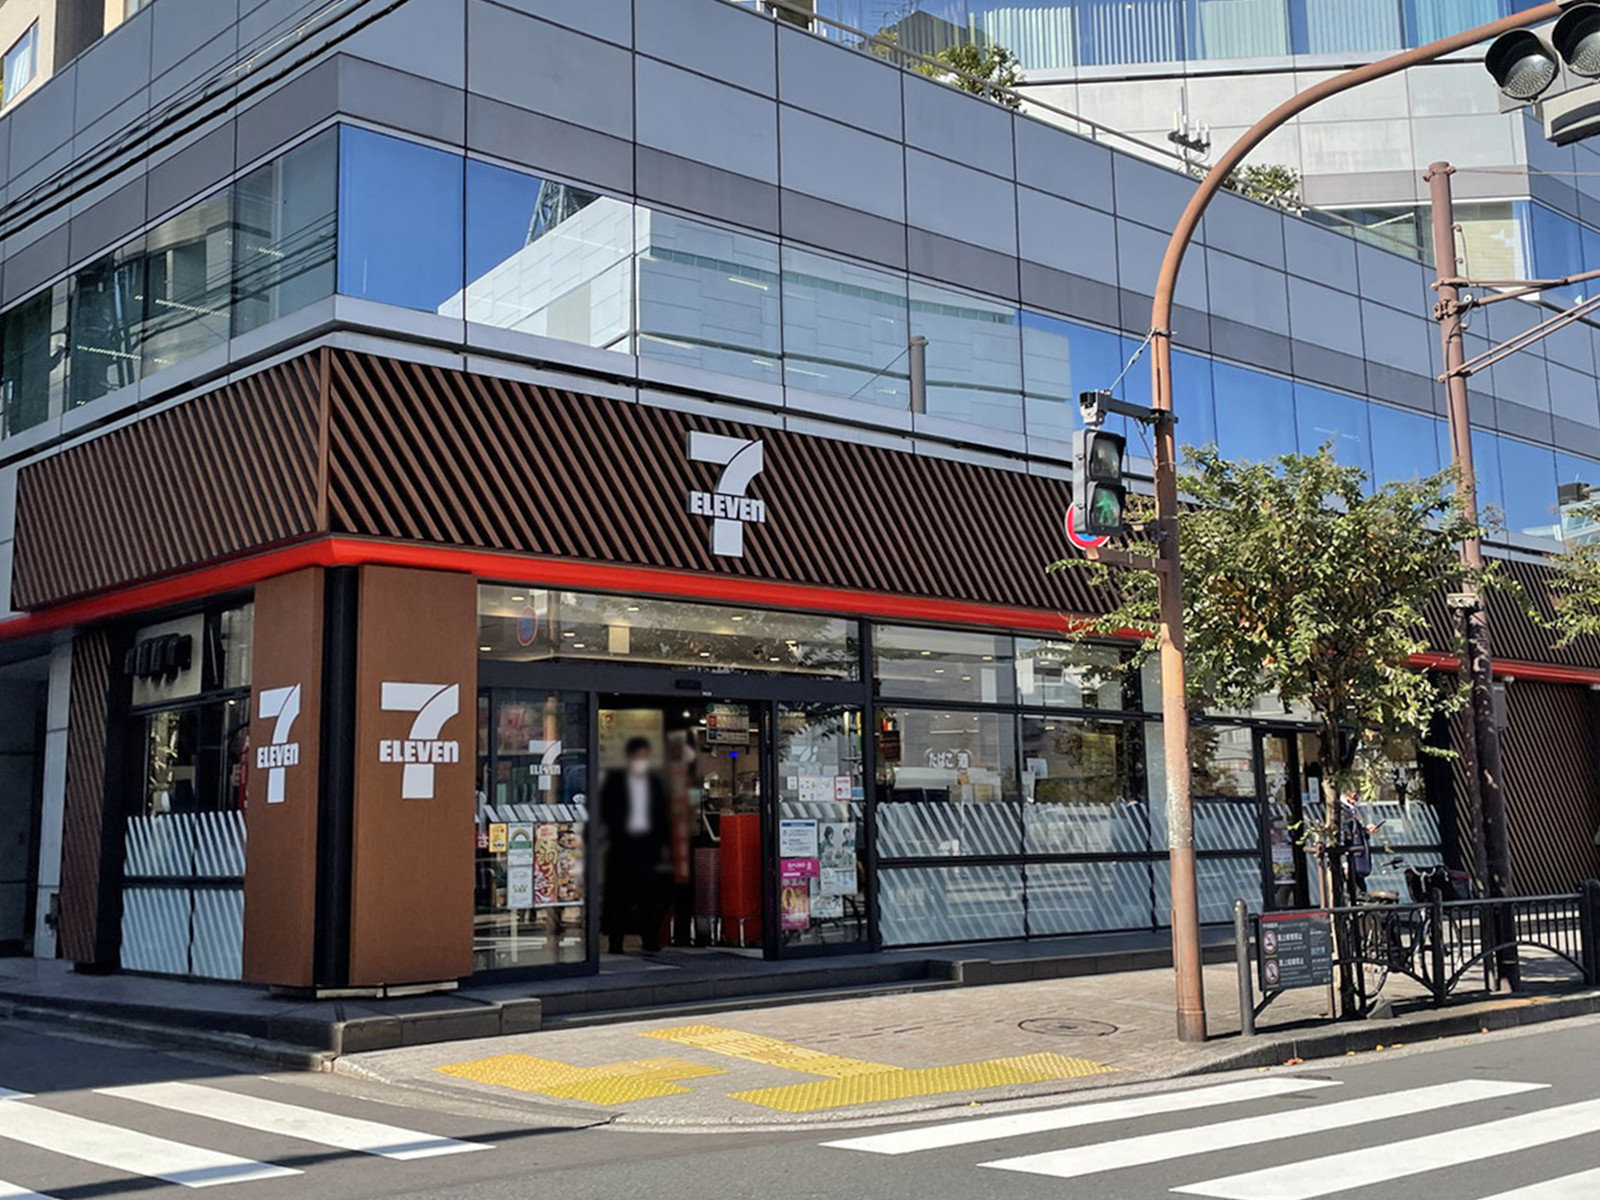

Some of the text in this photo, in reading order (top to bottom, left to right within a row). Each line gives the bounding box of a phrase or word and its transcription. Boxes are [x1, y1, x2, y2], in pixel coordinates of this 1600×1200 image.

[687, 430, 764, 557] 7
[258, 683, 301, 803] 7
[381, 681, 460, 799] 7
